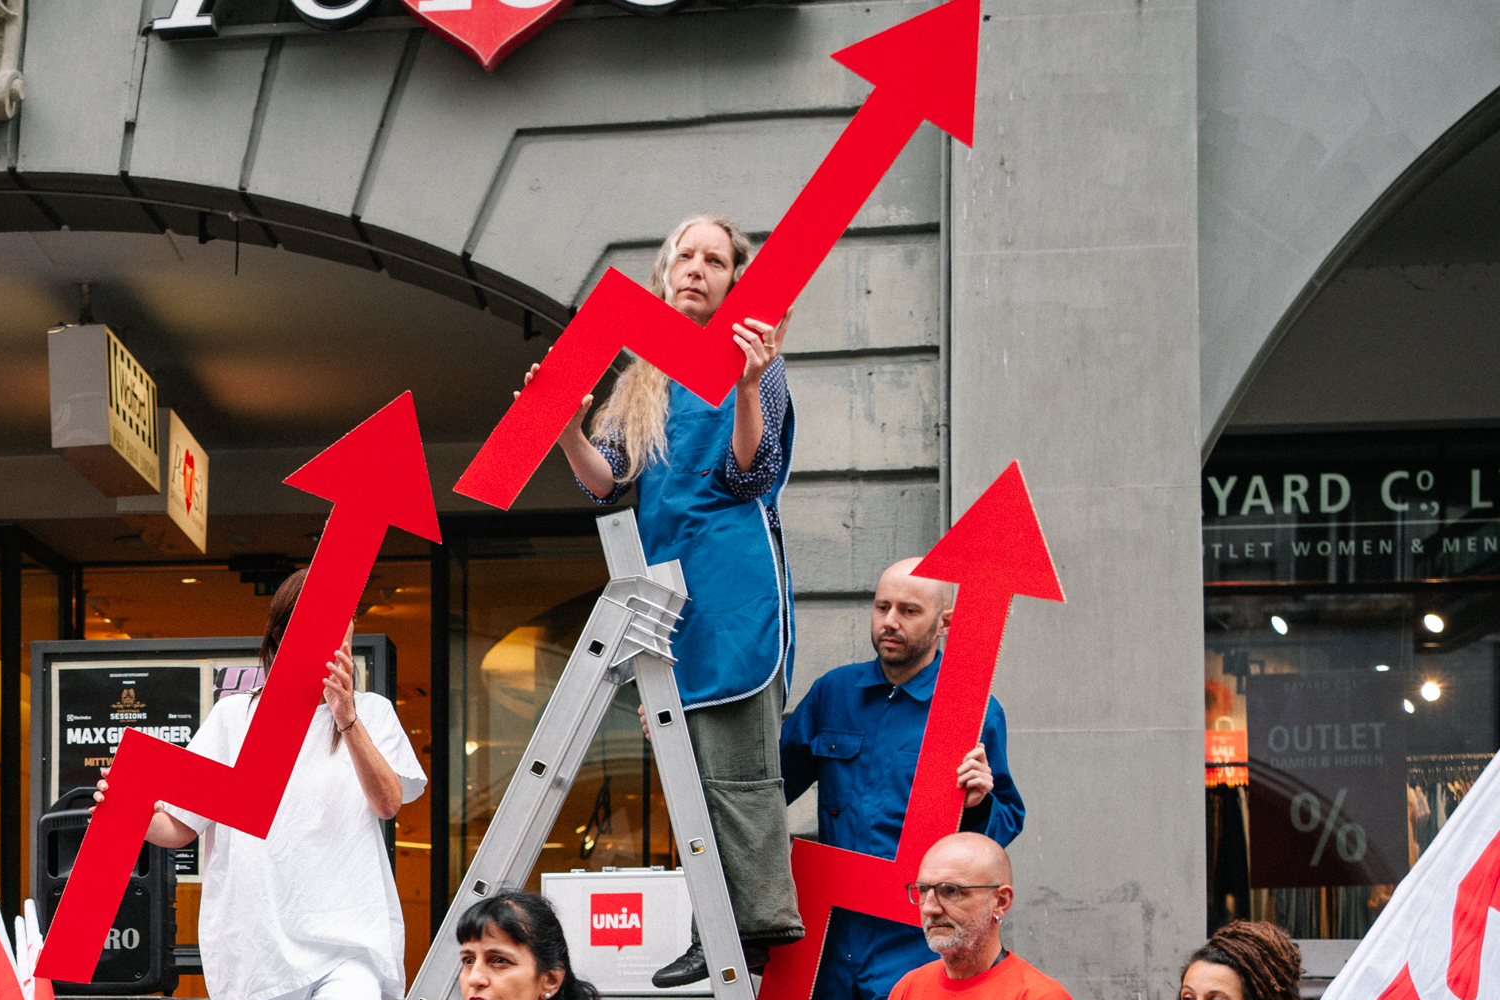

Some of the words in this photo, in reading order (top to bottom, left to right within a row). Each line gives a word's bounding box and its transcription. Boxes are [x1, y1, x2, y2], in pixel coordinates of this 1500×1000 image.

[1202, 472, 1351, 516] YARD
[1471, 468, 1498, 509] L
[1205, 541, 1274, 560] TLET
[1291, 539, 1393, 557] WOMEN
[1410, 538, 1424, 555] &
[1442, 535, 1498, 554] MEN
[66, 727, 106, 744] MAX
[1268, 721, 1386, 752] OUTLET
[1270, 756, 1317, 769] DAMEN
[1334, 754, 1384, 767] HERREN
[1290, 788, 1368, 867] %
